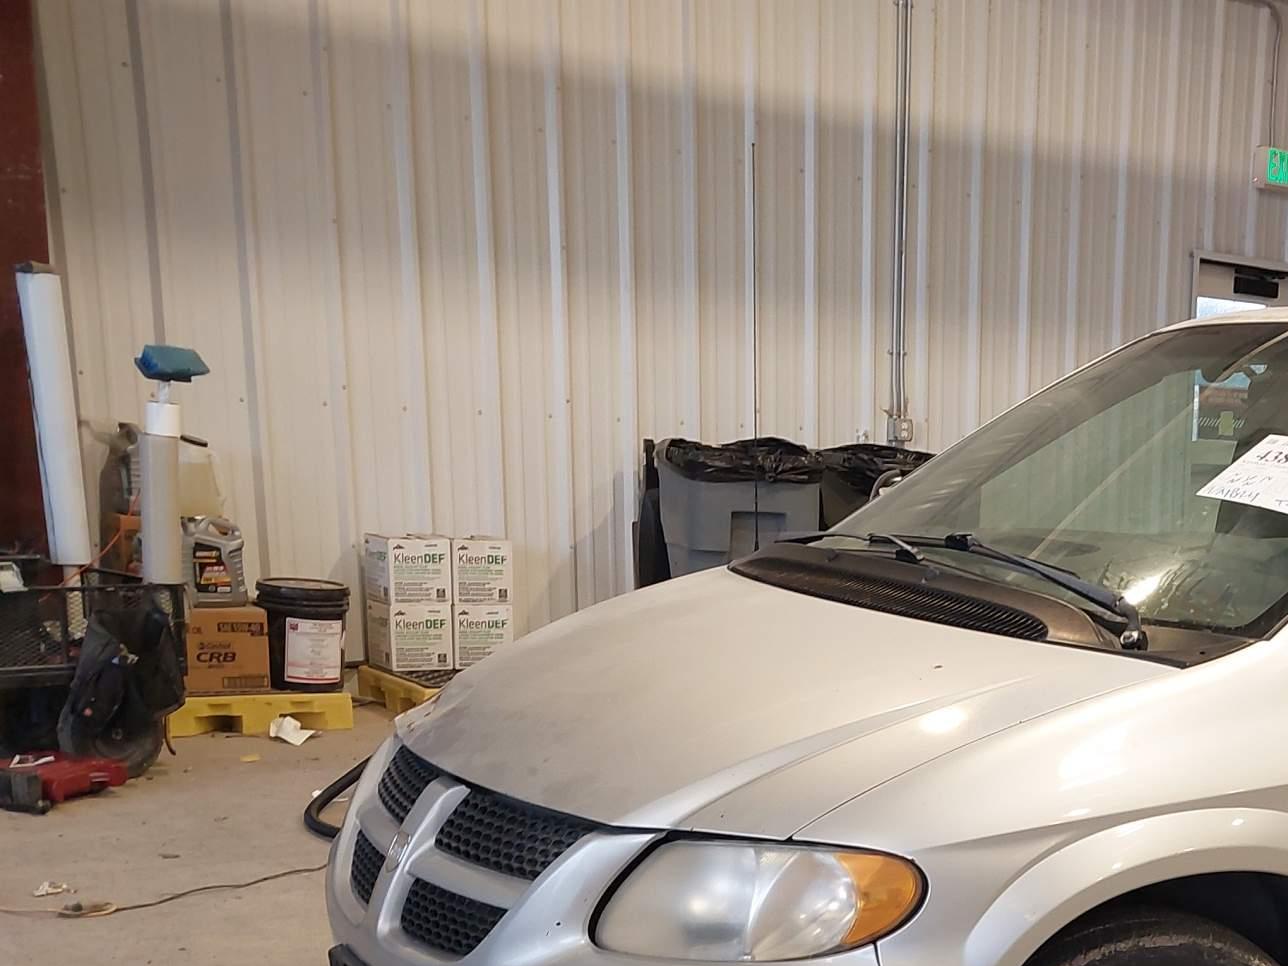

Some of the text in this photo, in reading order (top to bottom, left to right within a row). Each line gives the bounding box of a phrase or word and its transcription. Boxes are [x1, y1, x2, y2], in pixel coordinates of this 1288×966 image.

[393, 553, 446, 564] KleenDEF
[458, 553, 507, 564] KleenDEF
[395, 619, 447, 630] KleenDEF
[458, 619, 509, 629] KleenDEF
[196, 652, 237, 663] CRB
